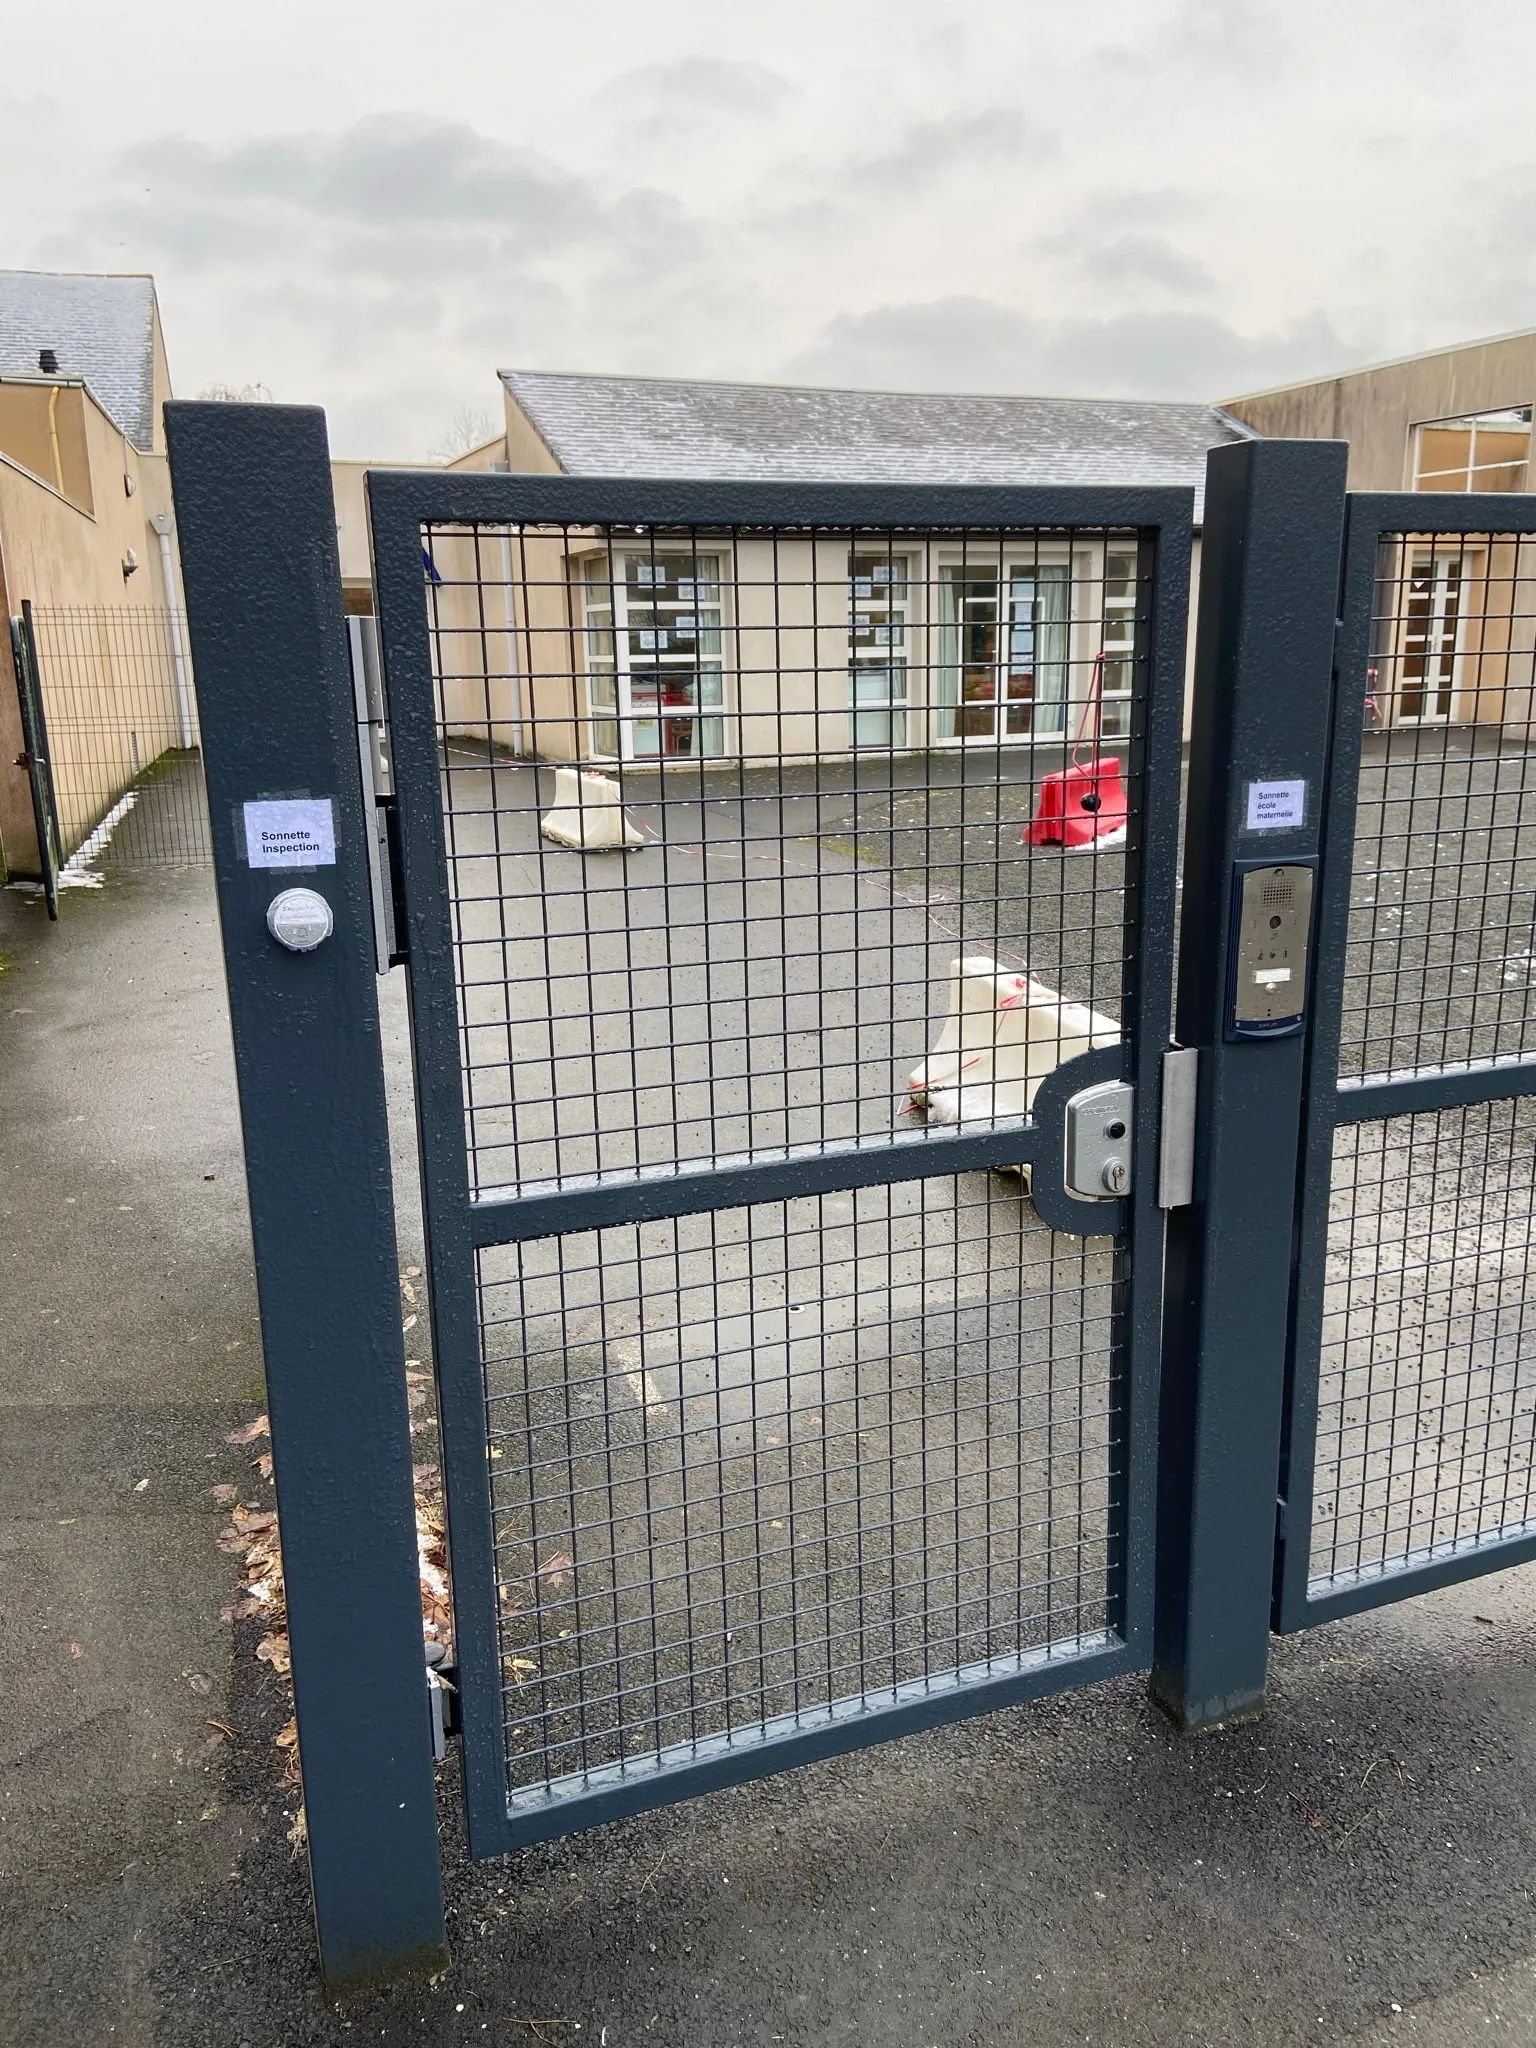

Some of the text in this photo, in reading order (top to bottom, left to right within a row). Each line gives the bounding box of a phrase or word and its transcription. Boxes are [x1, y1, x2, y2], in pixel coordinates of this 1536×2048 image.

[1258, 791, 1290, 800] Sonnette
[1257, 801, 1277, 810] école
[1256, 810, 1294, 820] maternelle
[261, 831, 311, 841] Sonnette
[262, 842, 320, 855] Inspection
